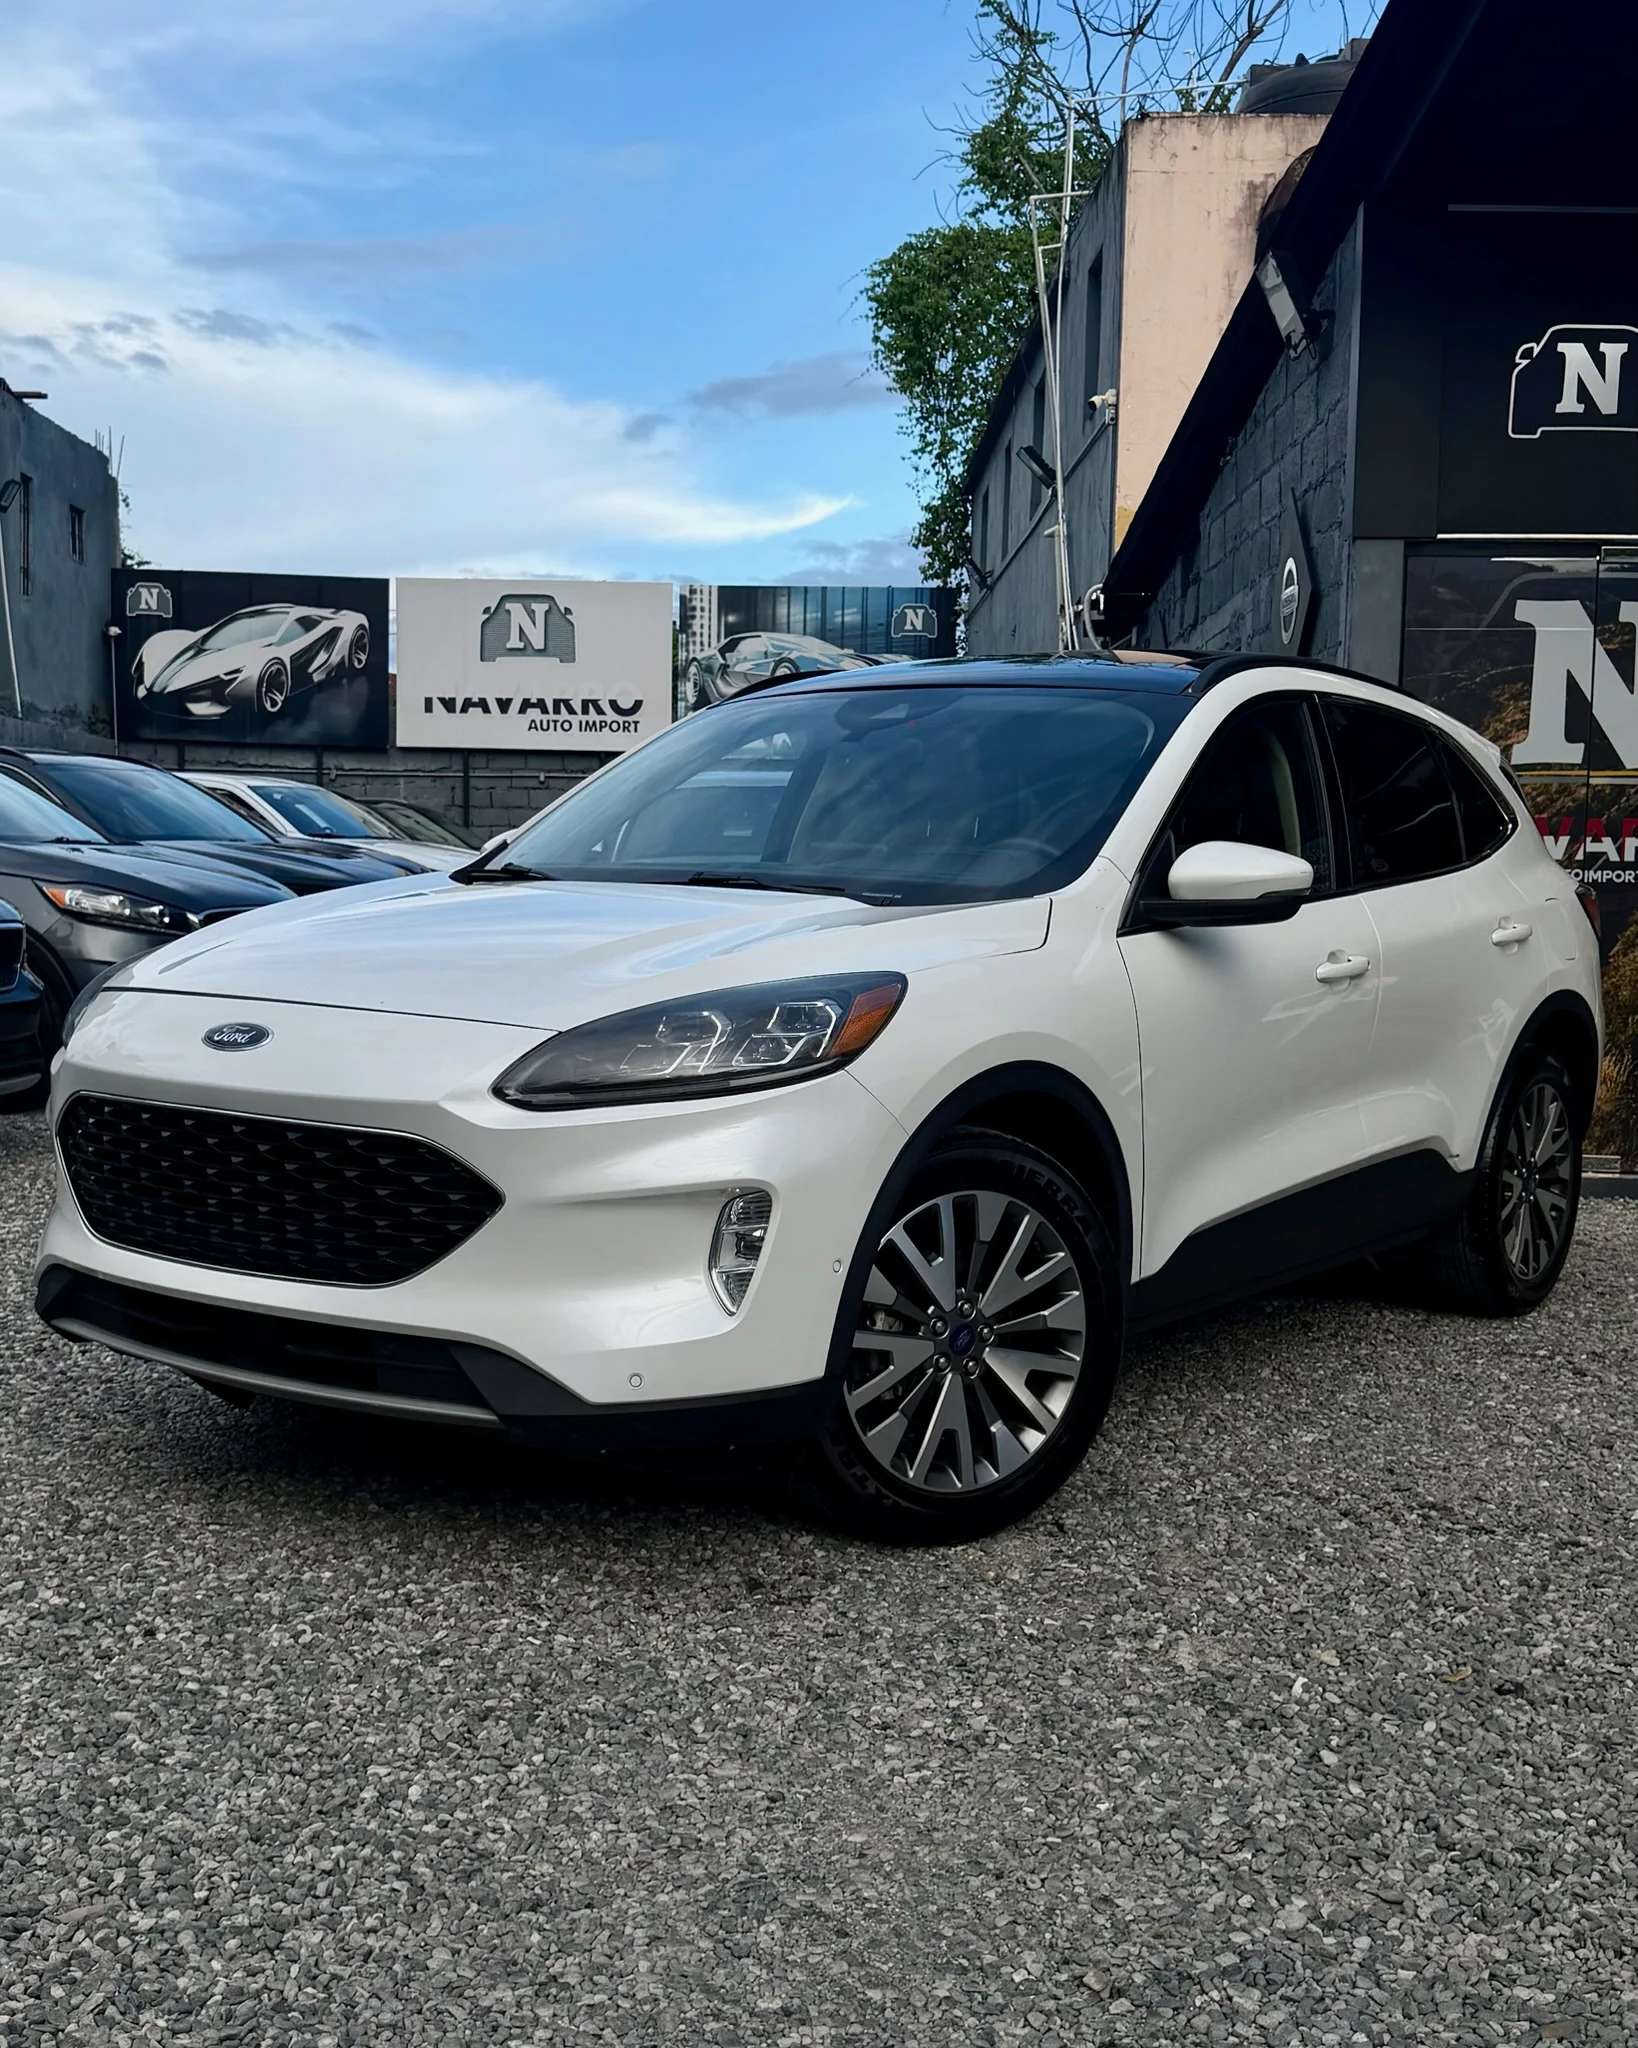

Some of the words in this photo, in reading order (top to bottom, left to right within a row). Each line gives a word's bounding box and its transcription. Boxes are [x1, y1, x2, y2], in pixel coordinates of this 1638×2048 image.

[1555, 342, 1628, 415] N
[139, 587, 159, 610] N
[505, 603, 549, 650] N
[904, 609, 925, 631] N
[1510, 600, 1638, 769] N
[528, 719, 573, 733] AUTO
[578, 719, 640, 733] IMPORT
